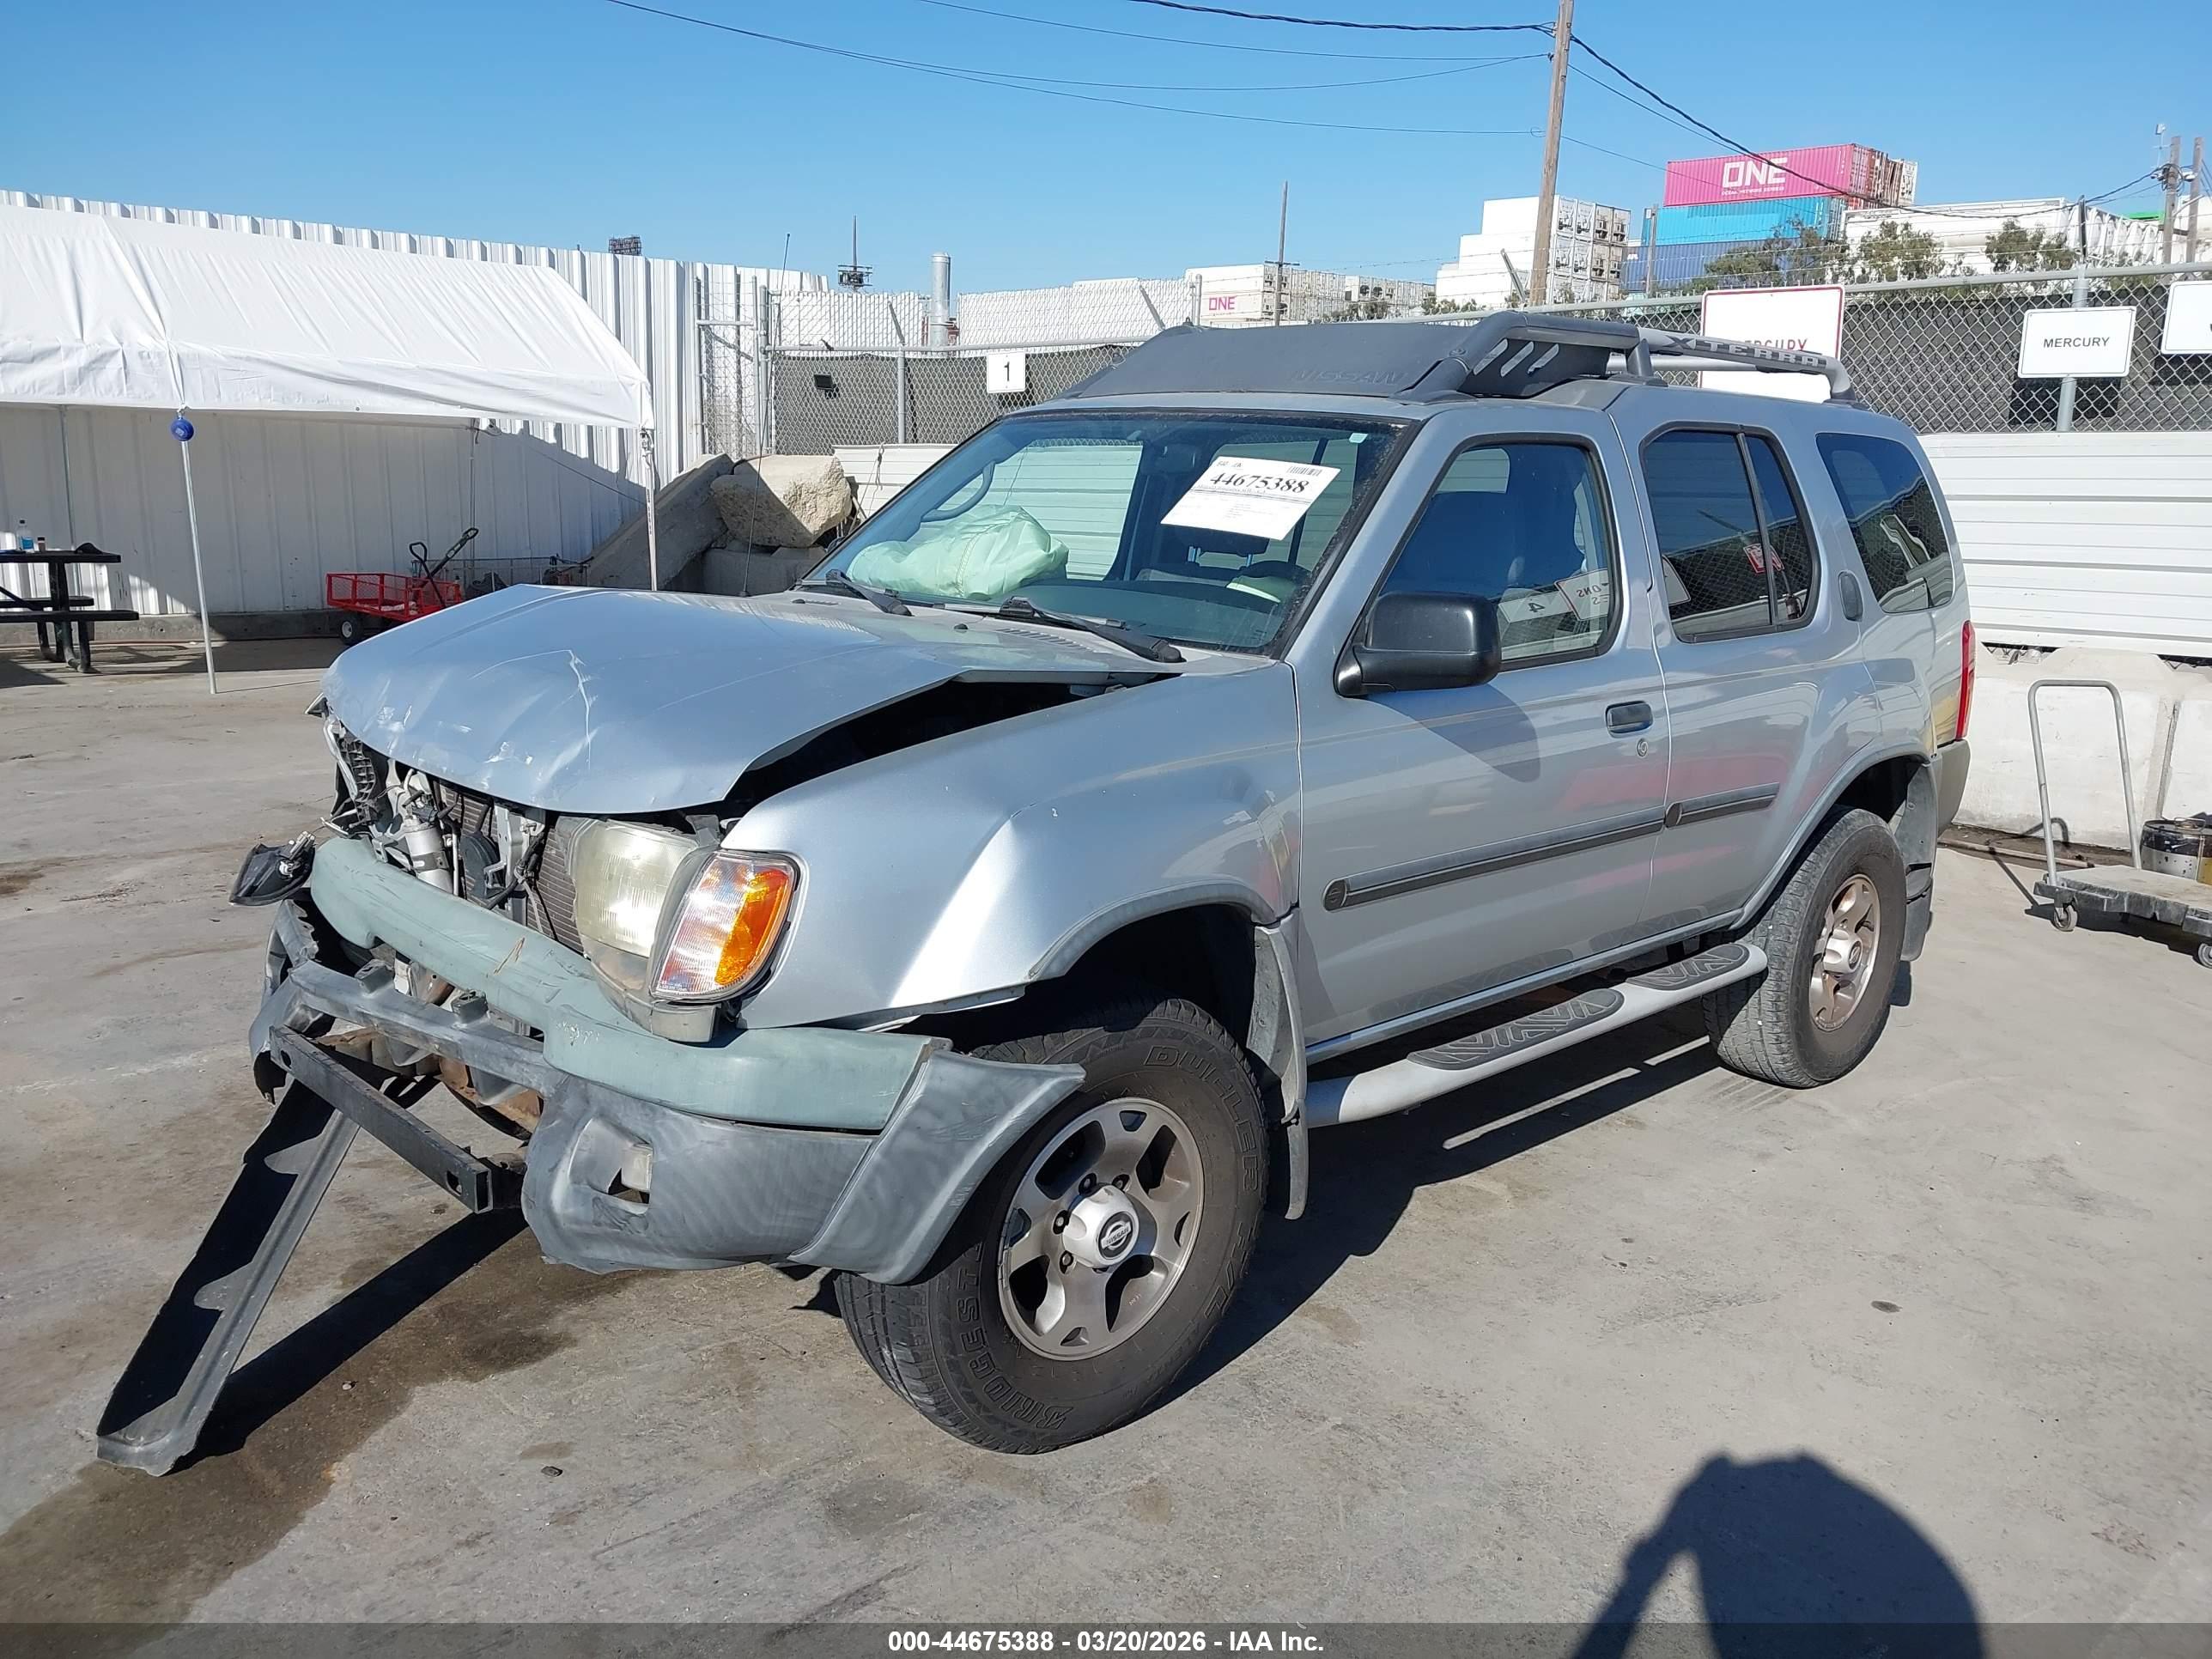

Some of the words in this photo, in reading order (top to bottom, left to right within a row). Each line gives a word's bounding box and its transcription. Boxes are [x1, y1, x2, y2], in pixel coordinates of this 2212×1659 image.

[1722, 156, 1787, 188] ONE
[1209, 295, 1237, 311] ONE
[1666, 334, 1819, 368] XTERRA
[2043, 337, 2110, 348] MERCURY
[1003, 361, 1010, 382] 1
[1209, 472, 1310, 494] 44675388
[1143, 1044, 1259, 1192] DUELER
